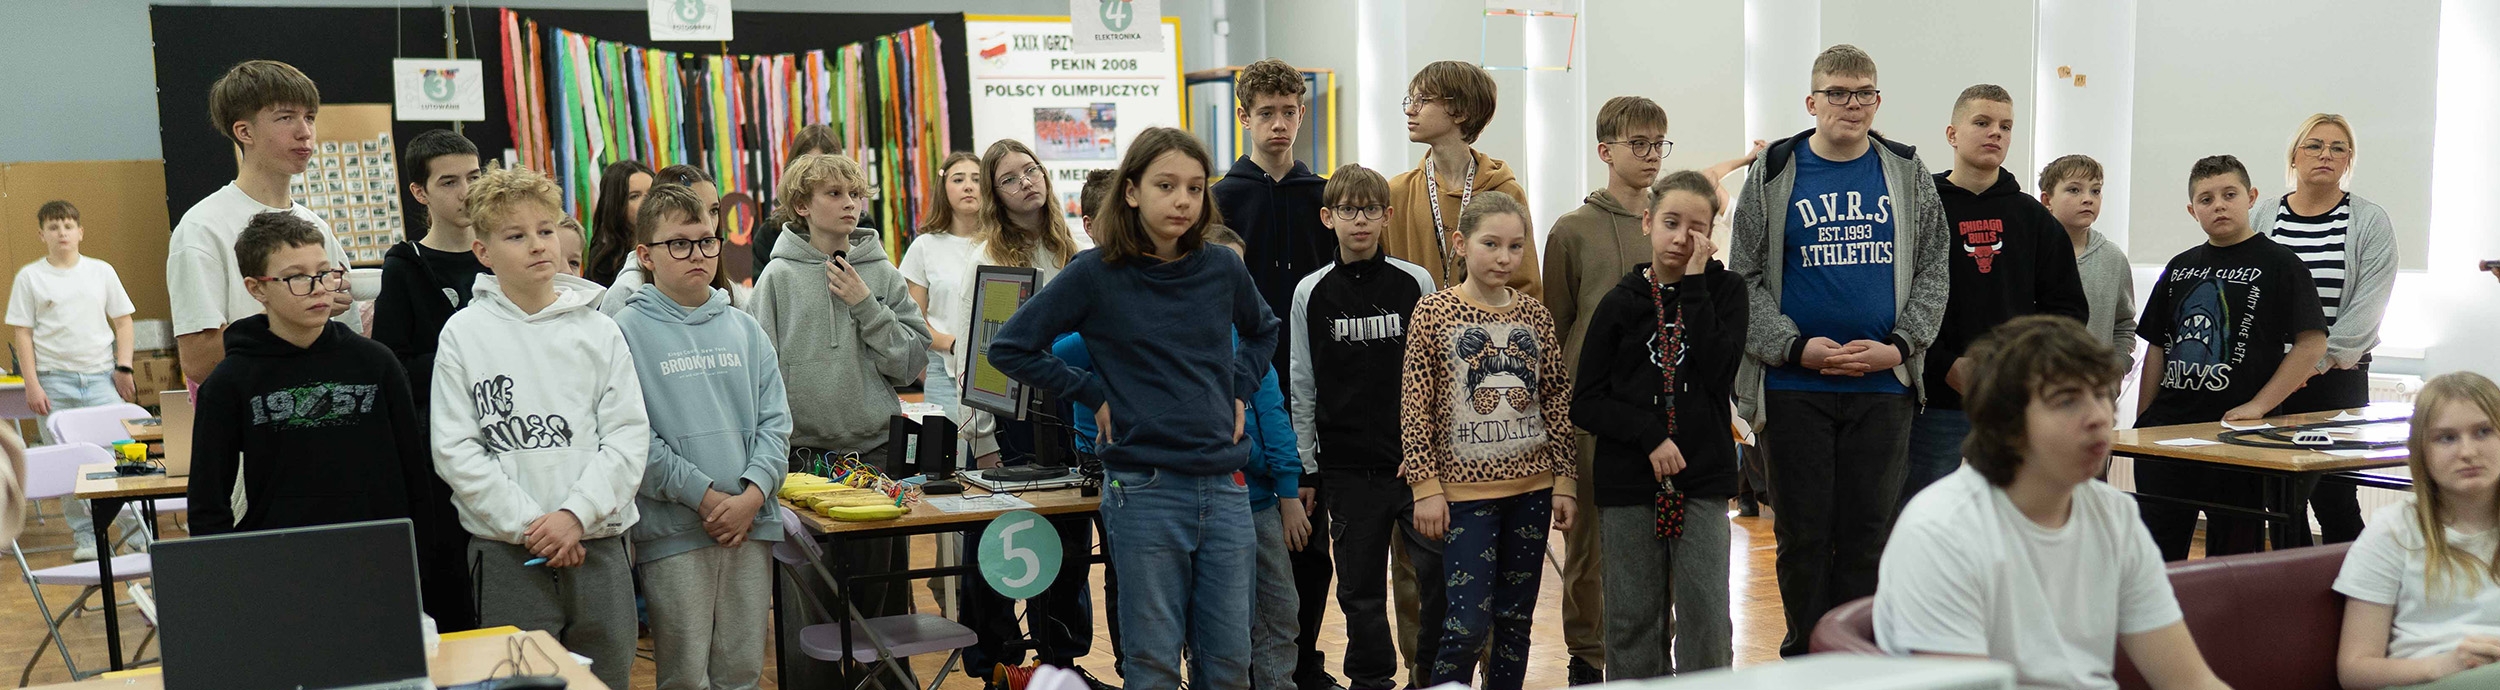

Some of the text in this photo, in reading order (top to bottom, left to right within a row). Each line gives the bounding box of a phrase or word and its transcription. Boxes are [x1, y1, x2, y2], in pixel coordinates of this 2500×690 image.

[683, 0, 699, 19] 8
[1105, 0, 1126, 28] 4
[1013, 35, 1073, 51] XXIX IGRZY
[1094, 33, 1141, 41] ELEKTRONIKA
[1051, 59, 1138, 71] PEKIN 2008
[432, 76, 448, 98] 3
[985, 84, 1160, 97] POLSCY OLIMPIJCZYCY
[1818, 224, 1872, 242] EST.1993
[1959, 219, 2003, 235] CHICAGO
[1968, 231, 1997, 244] BULLS
[1800, 241, 1893, 268] ATHLETICS
[2170, 267, 2262, 282] BEACH CLOSED
[2247, 285, 2261, 310] AMITY
[1334, 313, 1400, 342] PUMA
[2238, 312, 2254, 339] POLICE
[718, 353, 742, 367] USA
[2161, 360, 2232, 392] AWS
[474, 375, 514, 420] AKE
[999, 518, 1040, 588] 5
